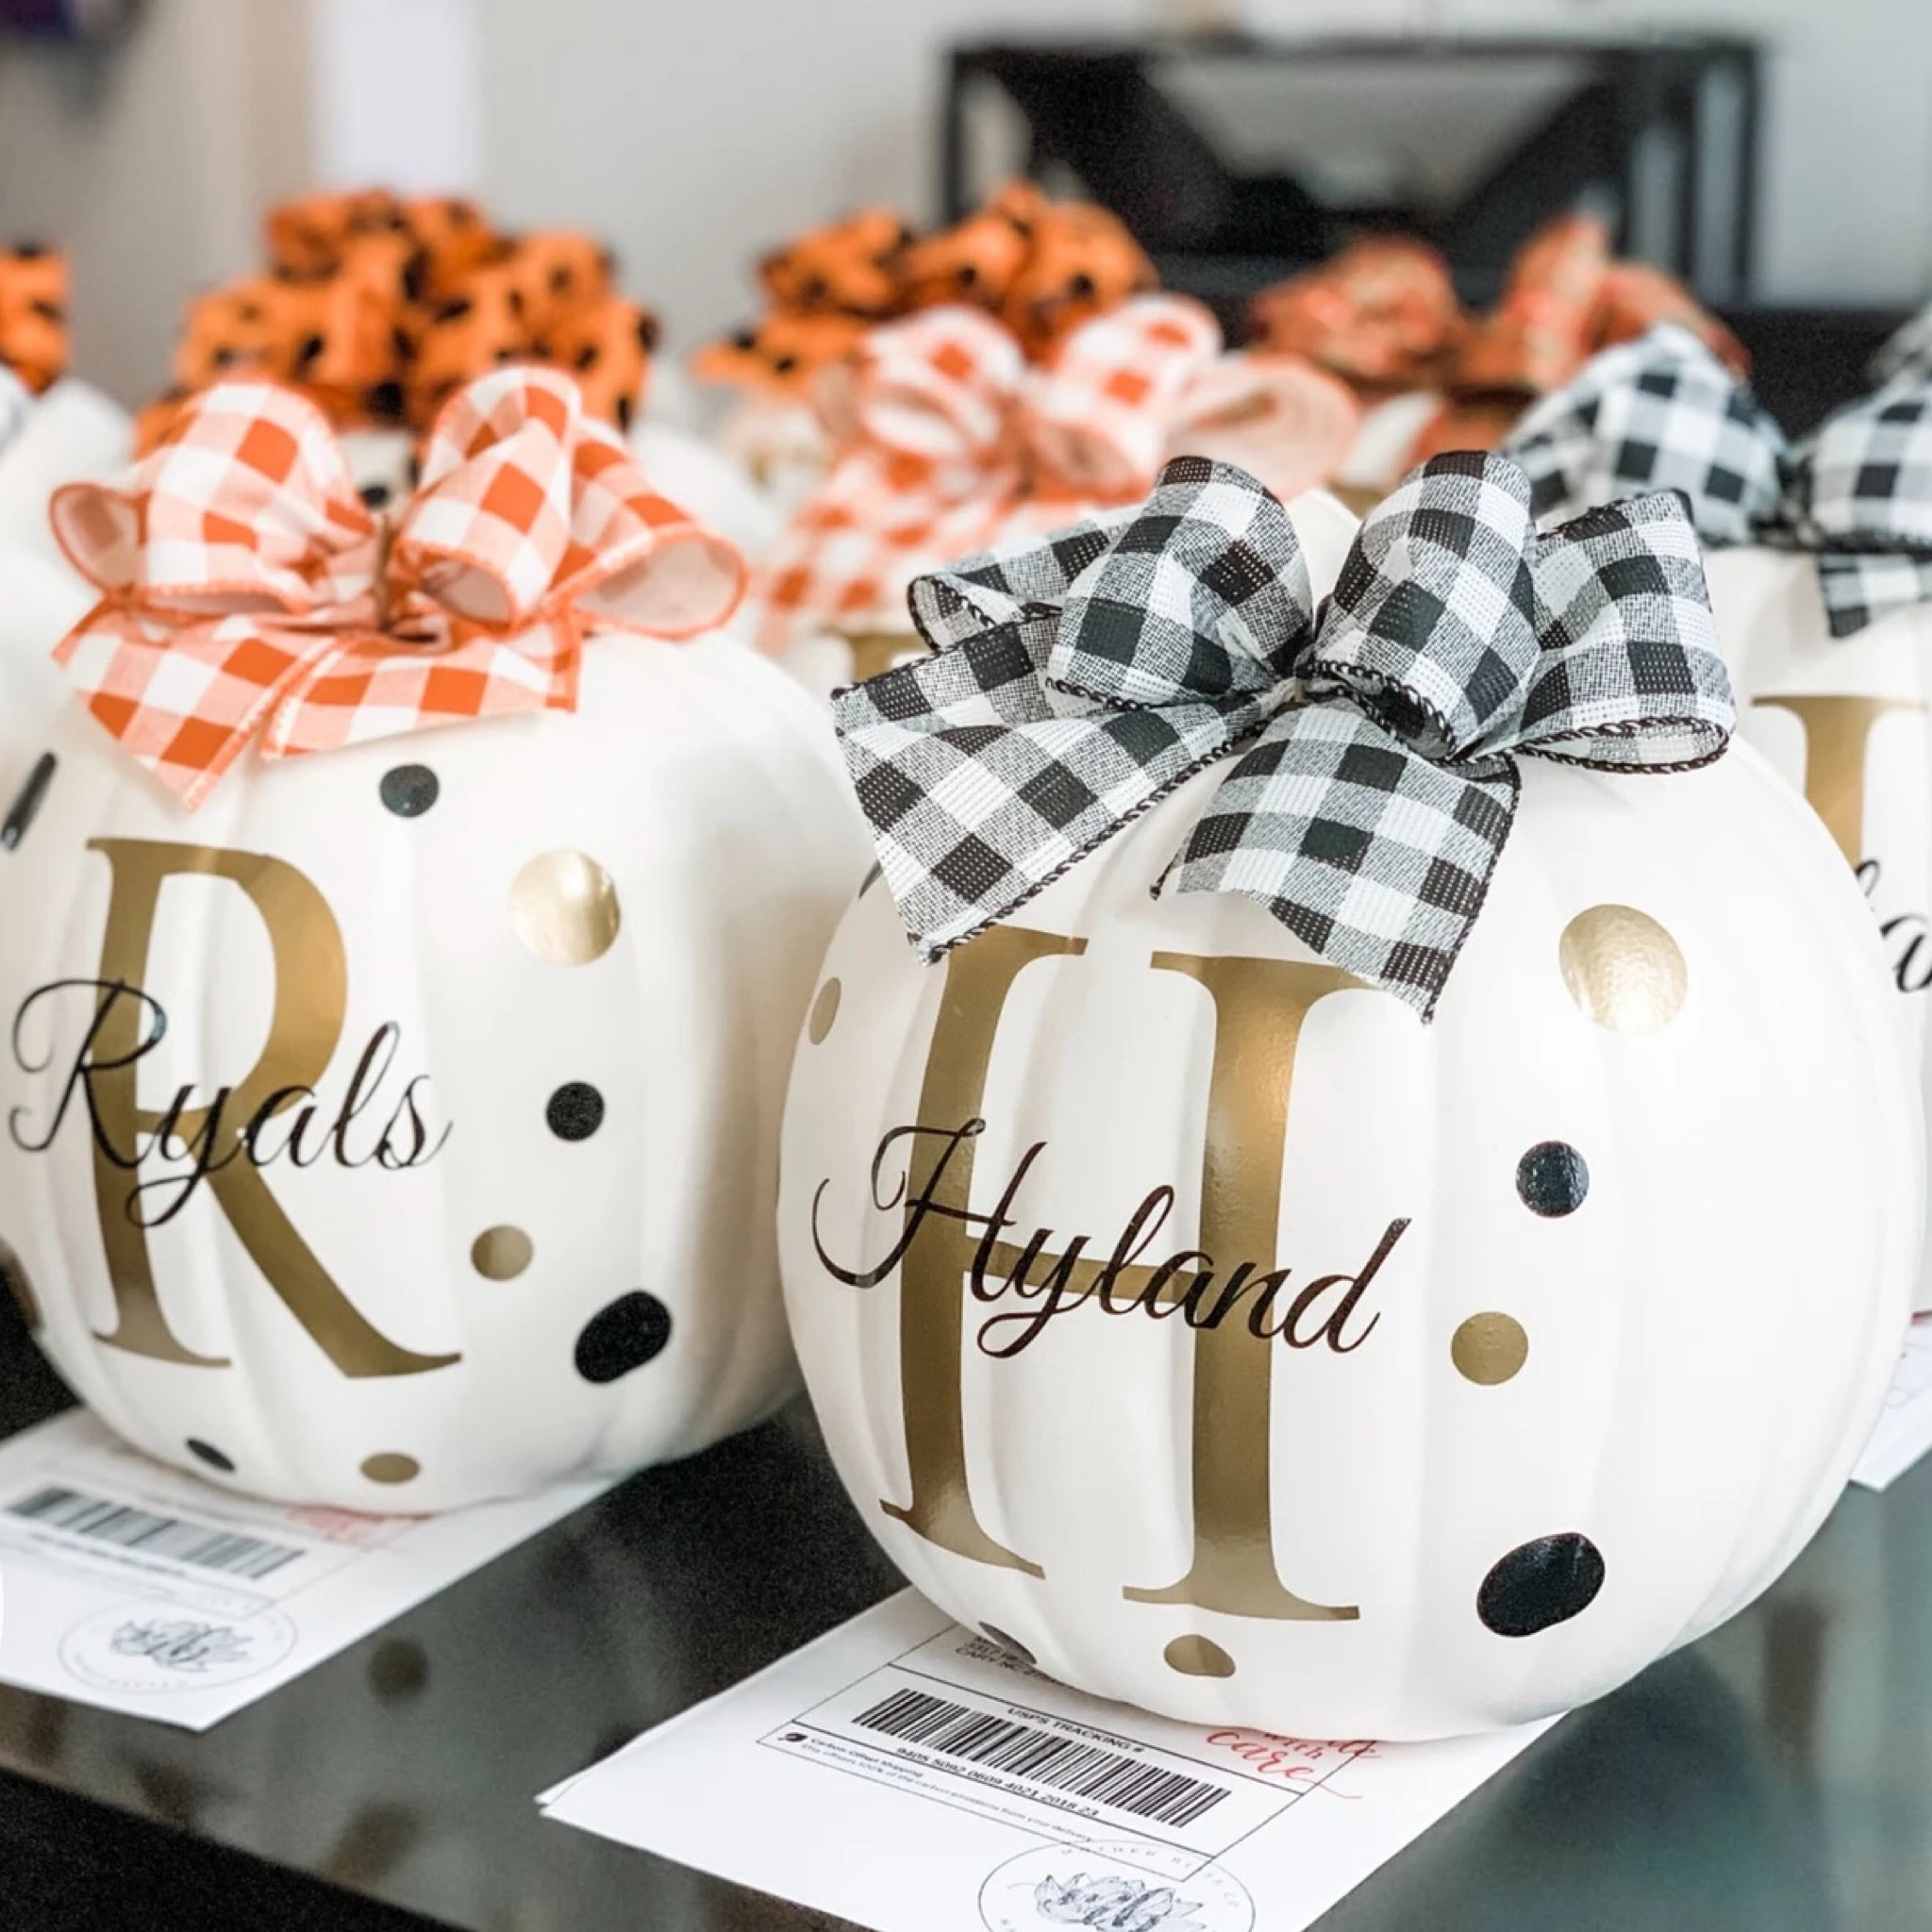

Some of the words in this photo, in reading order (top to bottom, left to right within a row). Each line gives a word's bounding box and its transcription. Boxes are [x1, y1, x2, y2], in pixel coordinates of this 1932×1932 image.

[8, 978, 454, 1227] Ryals
[87, 837, 462, 1378] R
[812, 1118, 1412, 1358] Hyland
[879, 924, 1394, 1621] H
[1008, 1707, 1050, 1725] USPS
[1053, 1721, 1130, 1750] TRACKING
